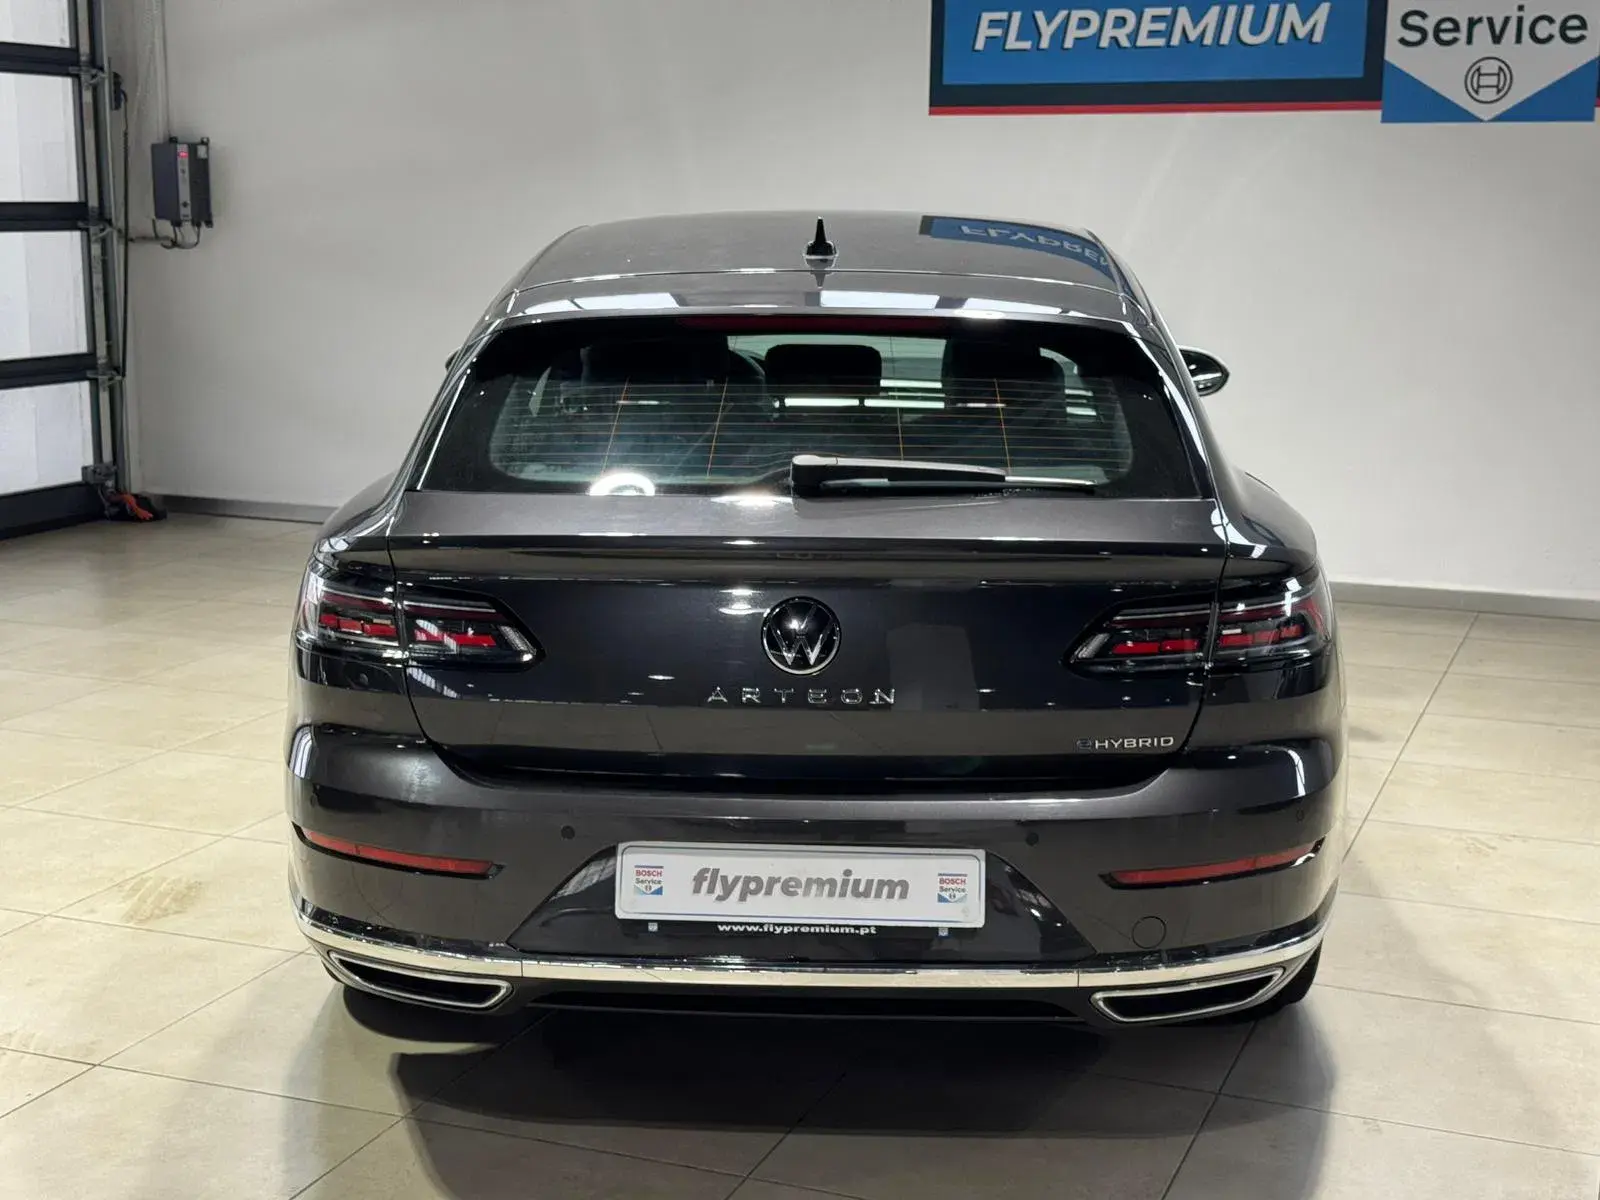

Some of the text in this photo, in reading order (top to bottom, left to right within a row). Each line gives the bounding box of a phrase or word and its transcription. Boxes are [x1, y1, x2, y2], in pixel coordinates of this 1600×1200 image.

[973, 2, 1331, 51] FLYPREMIUM
[1398, 5, 1588, 47] Service
[707, 686, 896, 704] ARTEON
[1076, 736, 1174, 750] eHYBRID
[635, 869, 663, 877] BOSCH
[635, 877, 663, 885] Service
[692, 868, 910, 902] flypremium
[939, 877, 966, 885] BOSCH
[717, 923, 877, 935] www.flypremium.pt
